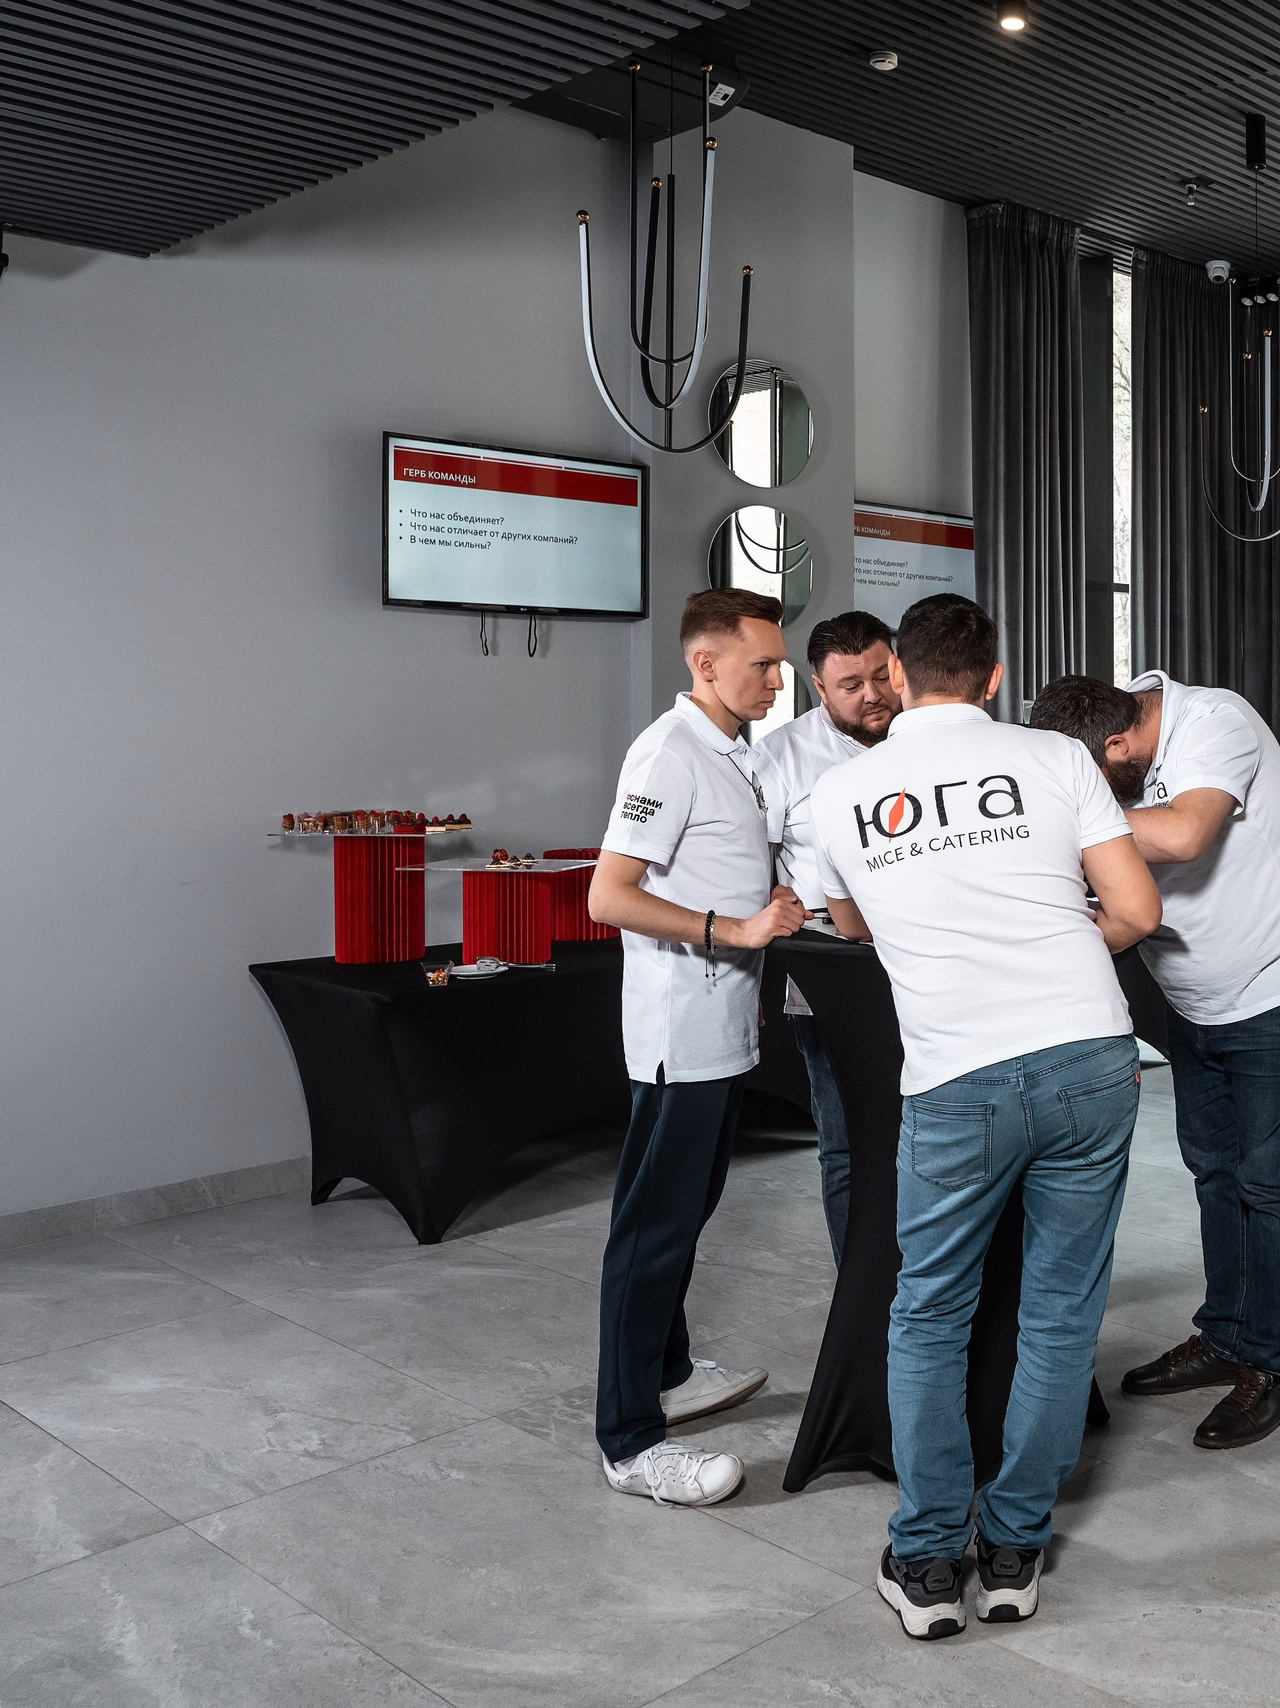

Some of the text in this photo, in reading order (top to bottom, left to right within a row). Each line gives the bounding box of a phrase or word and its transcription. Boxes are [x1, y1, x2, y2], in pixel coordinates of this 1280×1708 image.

[403, 467, 476, 484] ГЕРБ КОМАНДЫ
[410, 508, 504, 525] Что нас объединяет?
[410, 522, 578, 544] Что нас отличает от других компаний?
[861, 526, 890, 536] КОМАНДЫ
[410, 535, 416, 544] В
[454, 540, 491, 550] сильны?
[866, 824, 1030, 872] MICE & CATERING
